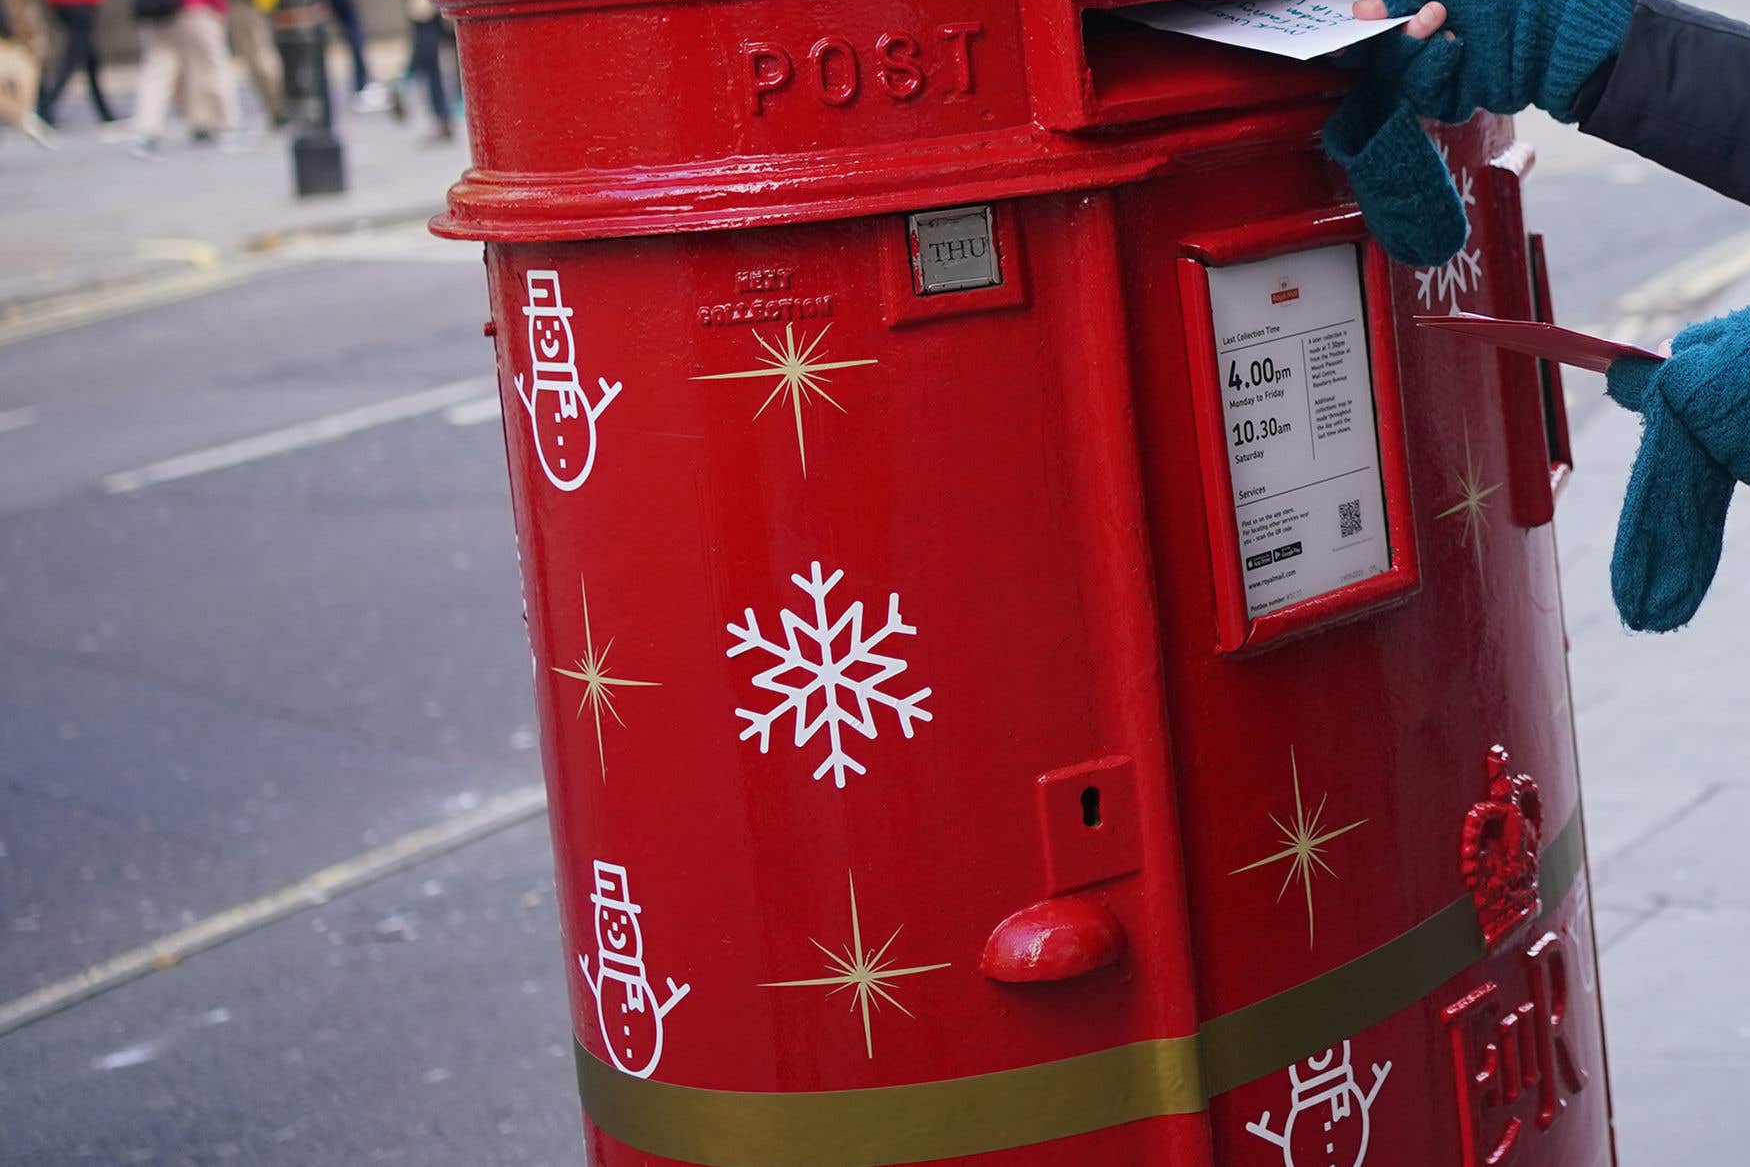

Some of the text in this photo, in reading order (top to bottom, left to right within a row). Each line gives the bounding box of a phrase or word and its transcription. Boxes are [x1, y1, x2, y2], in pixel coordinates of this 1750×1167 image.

[741, 21, 983, 117] POST
[928, 237, 986, 264] THU
[698, 294, 833, 325] COLLECTION
[1223, 325, 1280, 345] Last Collection Time
[1228, 357, 1291, 390] 4.00pm
[1229, 388, 1285, 409] Monday to Friday
[1233, 417, 1291, 446] 10.30am
[1235, 450, 1264, 464] Saturday
[1238, 485, 1266, 500] Services
[1242, 528, 1250, 537] For
[1269, 519, 1281, 528] other
[1281, 514, 1299, 525] services
[1265, 512, 1273, 521] the
[1256, 532, 1266, 542] scan
[1266, 529, 1274, 538] the
[1275, 527, 1282, 536] QR
[1248, 570, 1296, 590] www.royalmail.com
[1250, 601, 1267, 613] Postbox
